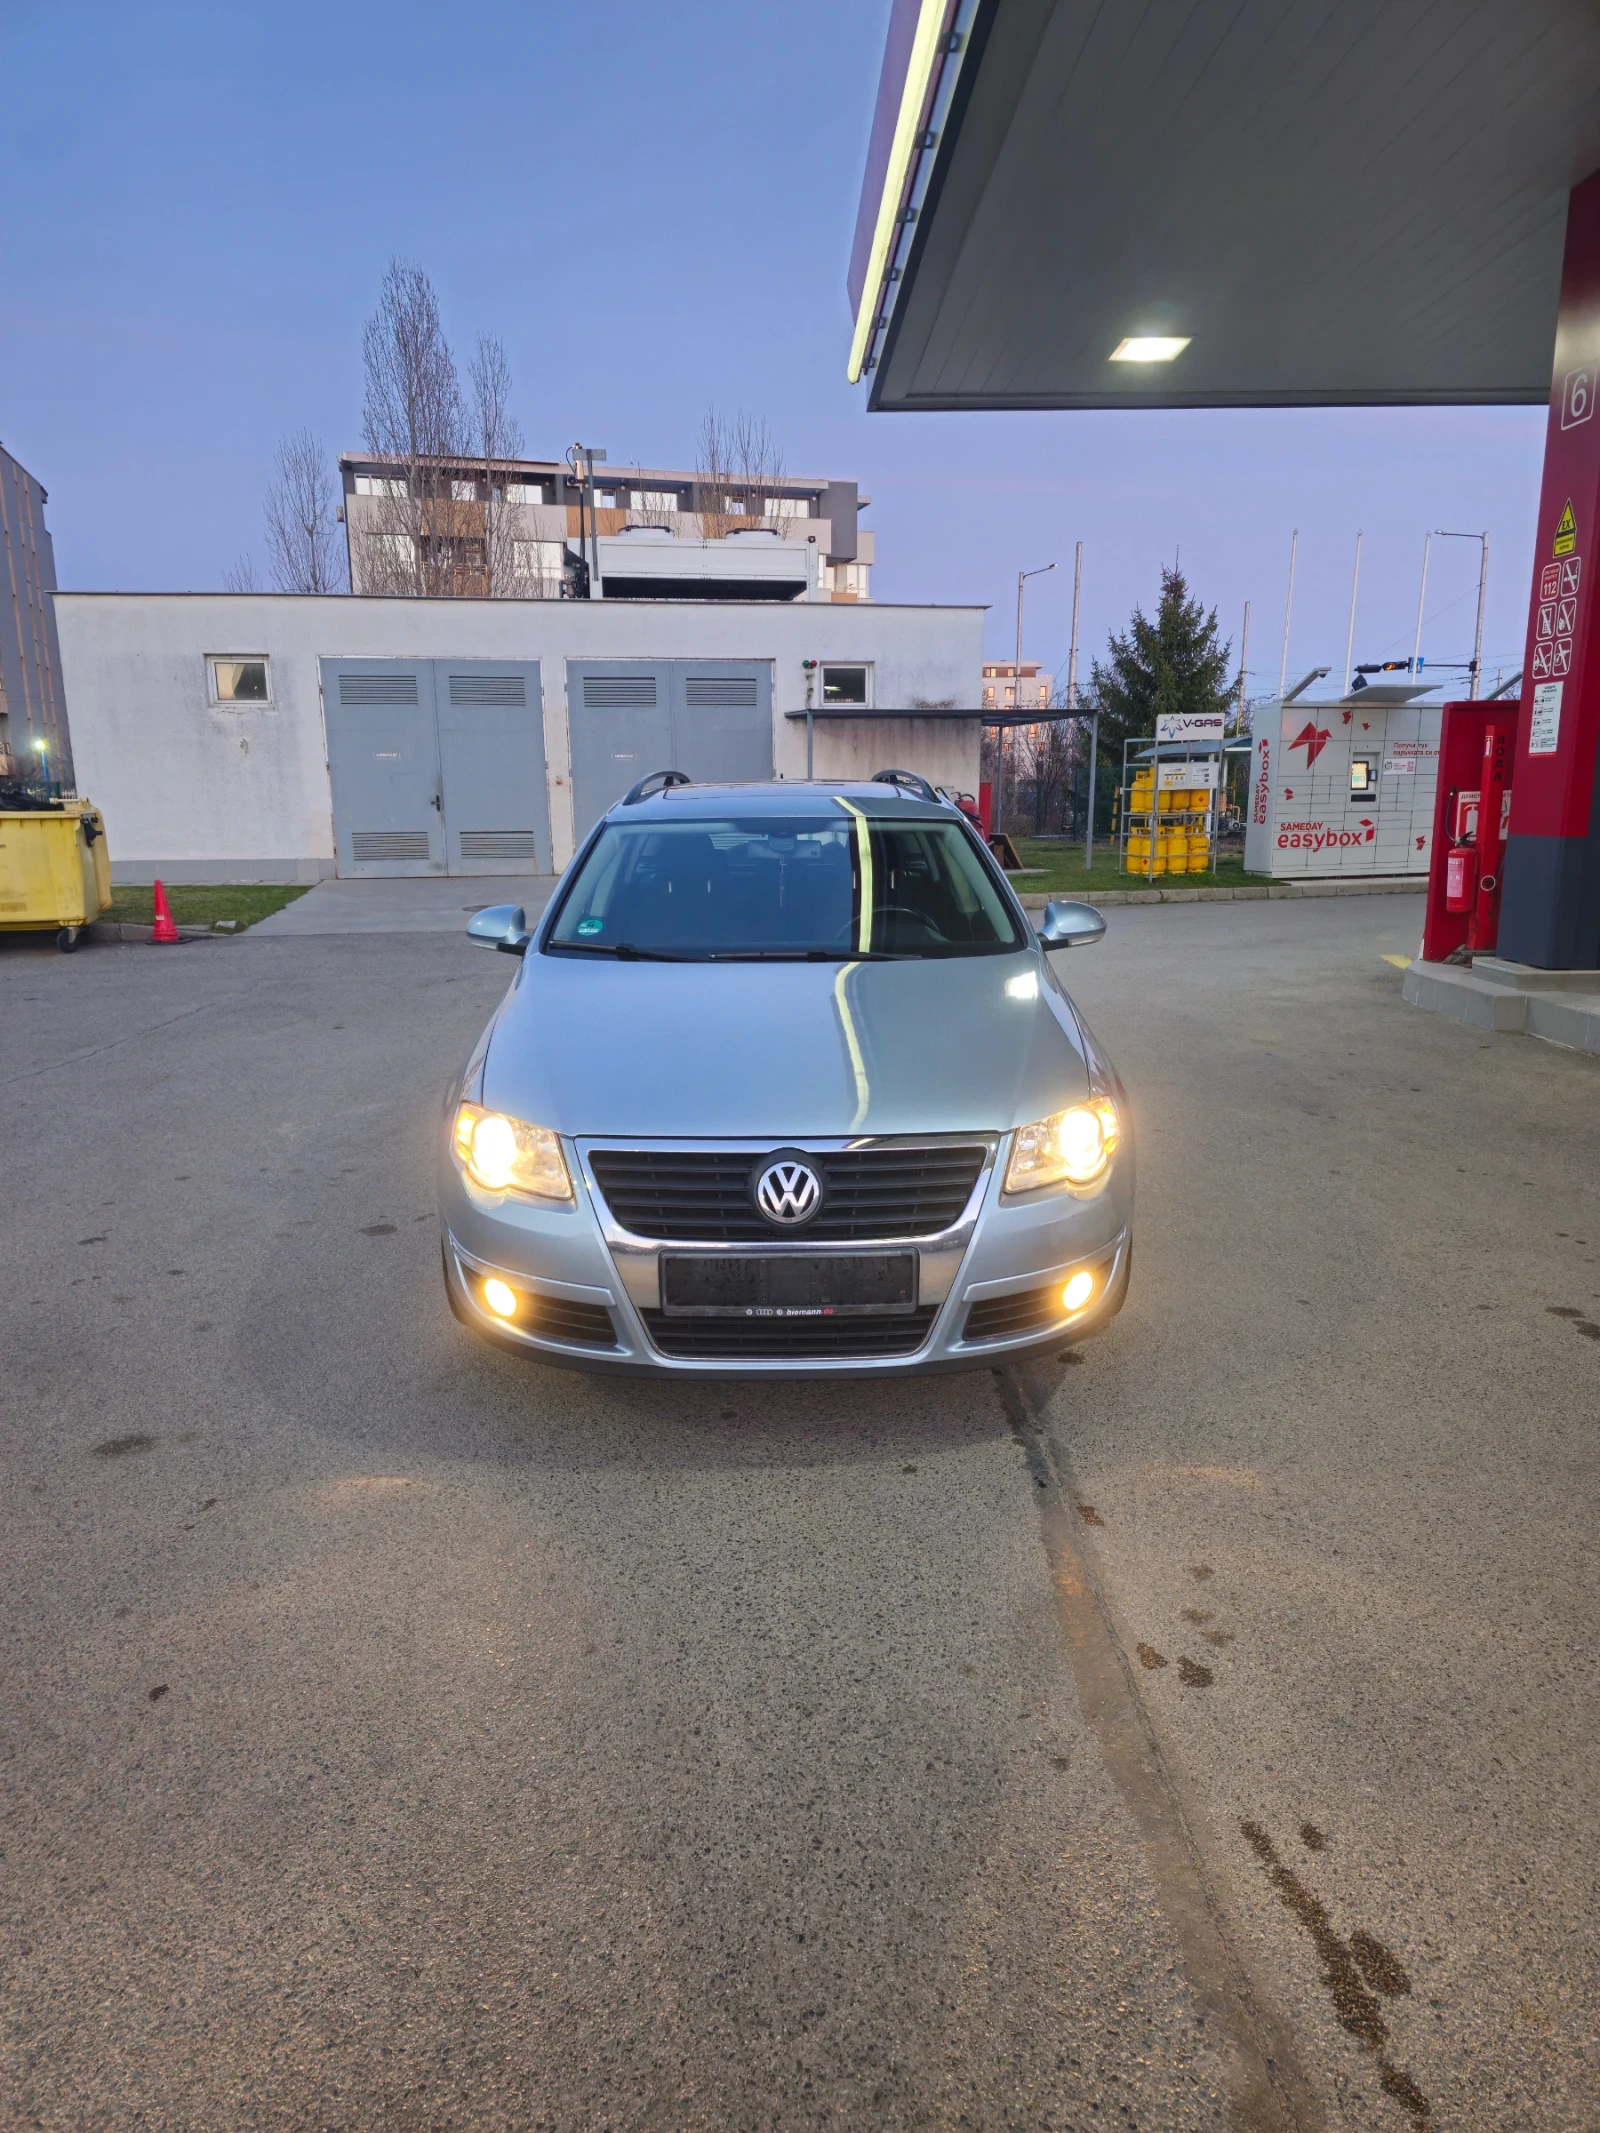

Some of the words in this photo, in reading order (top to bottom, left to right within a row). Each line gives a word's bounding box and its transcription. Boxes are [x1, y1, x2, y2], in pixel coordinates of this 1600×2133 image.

[1571, 373, 1588, 418] 6
[1543, 580, 1557, 595] 112
[1183, 718, 1223, 728] V-GAS
[1393, 742, 1416, 750] Получи
[1494, 735, 1505, 781] ВОДА
[1259, 749, 1270, 825] easybox
[1253, 783, 1261, 824] SAMEDAY
[1280, 821, 1324, 832] SAMEDAY
[1277, 827, 1362, 853] easybox
[786, 1308, 834, 1316] biemann.de
